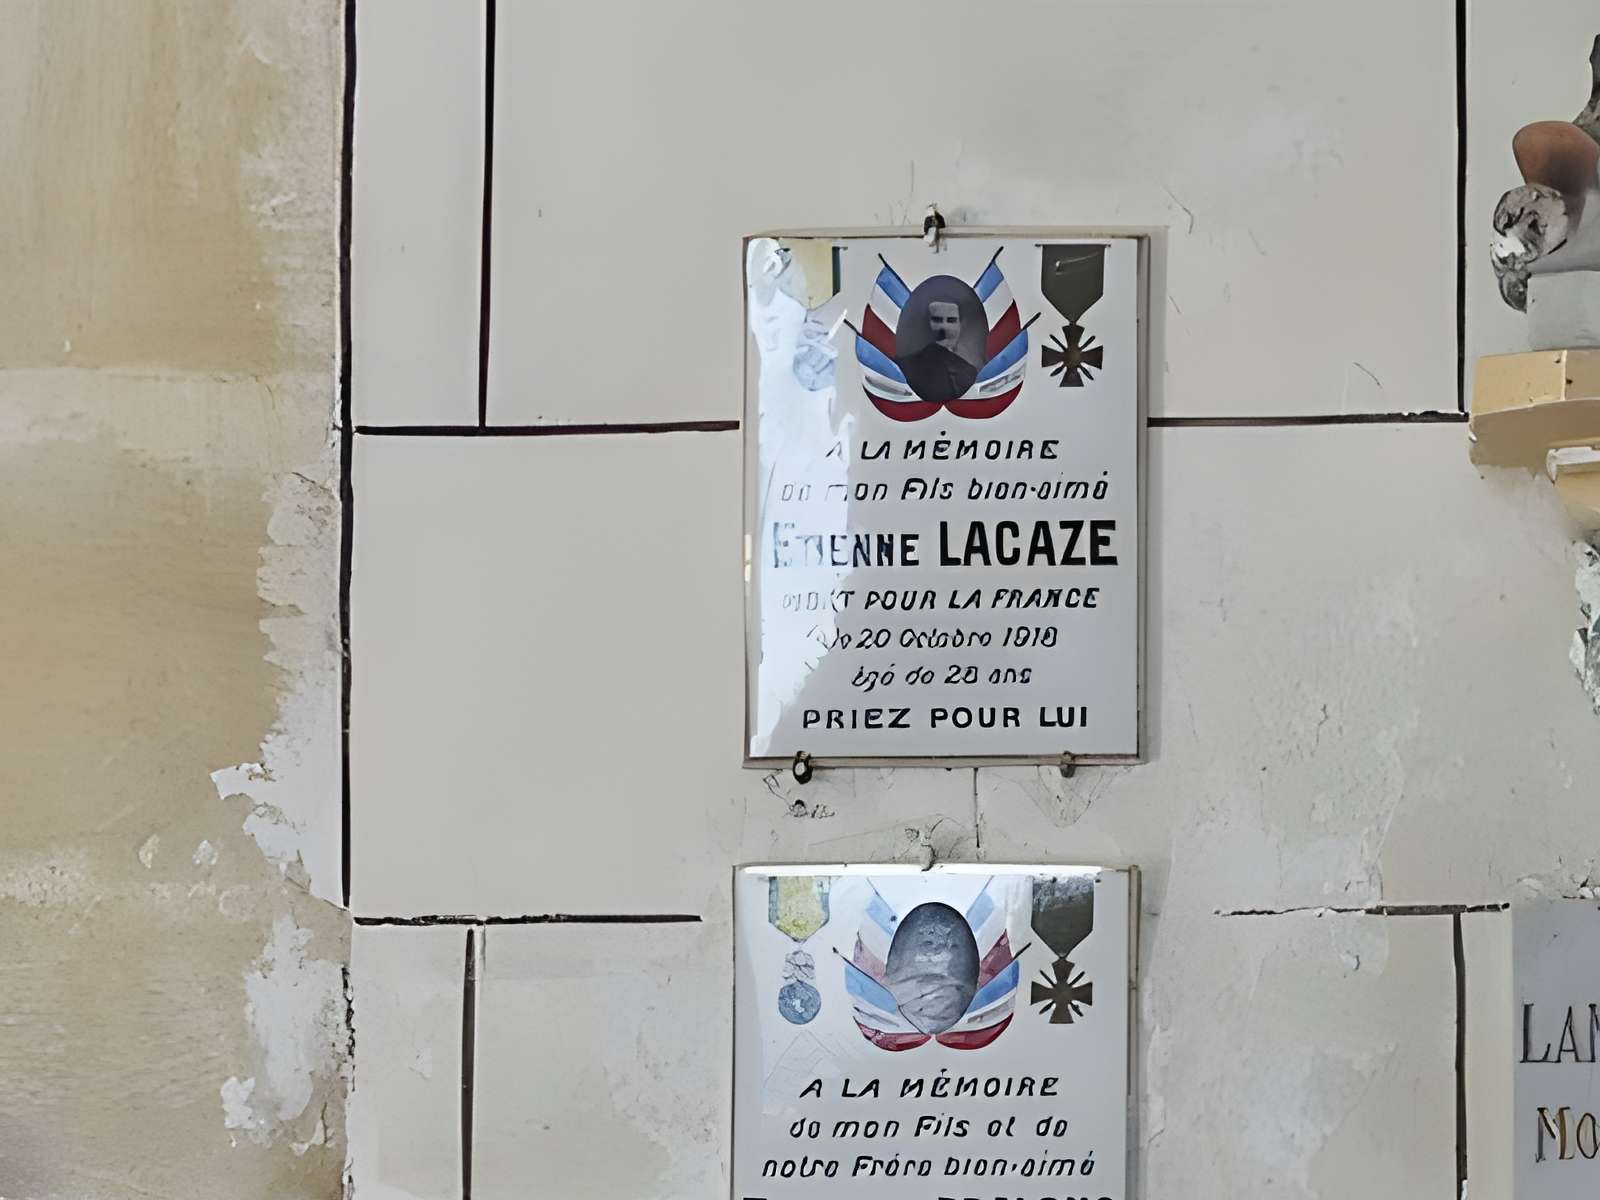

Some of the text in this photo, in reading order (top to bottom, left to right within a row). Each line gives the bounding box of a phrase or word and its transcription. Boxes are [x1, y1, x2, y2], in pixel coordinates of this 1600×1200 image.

[861, 431, 1060, 460] LA MÉMOIRE
[939, 520, 1119, 567] LACAZE
[865, 588, 1100, 610] POUR LA FRANCE
[856, 629, 891, 648] 20
[802, 707, 1088, 729] PRIEZ POUR LUI
[799, 1068, 1060, 1098] A LA MÉMOIRE
[832, 1115, 970, 1138] mon Fils
